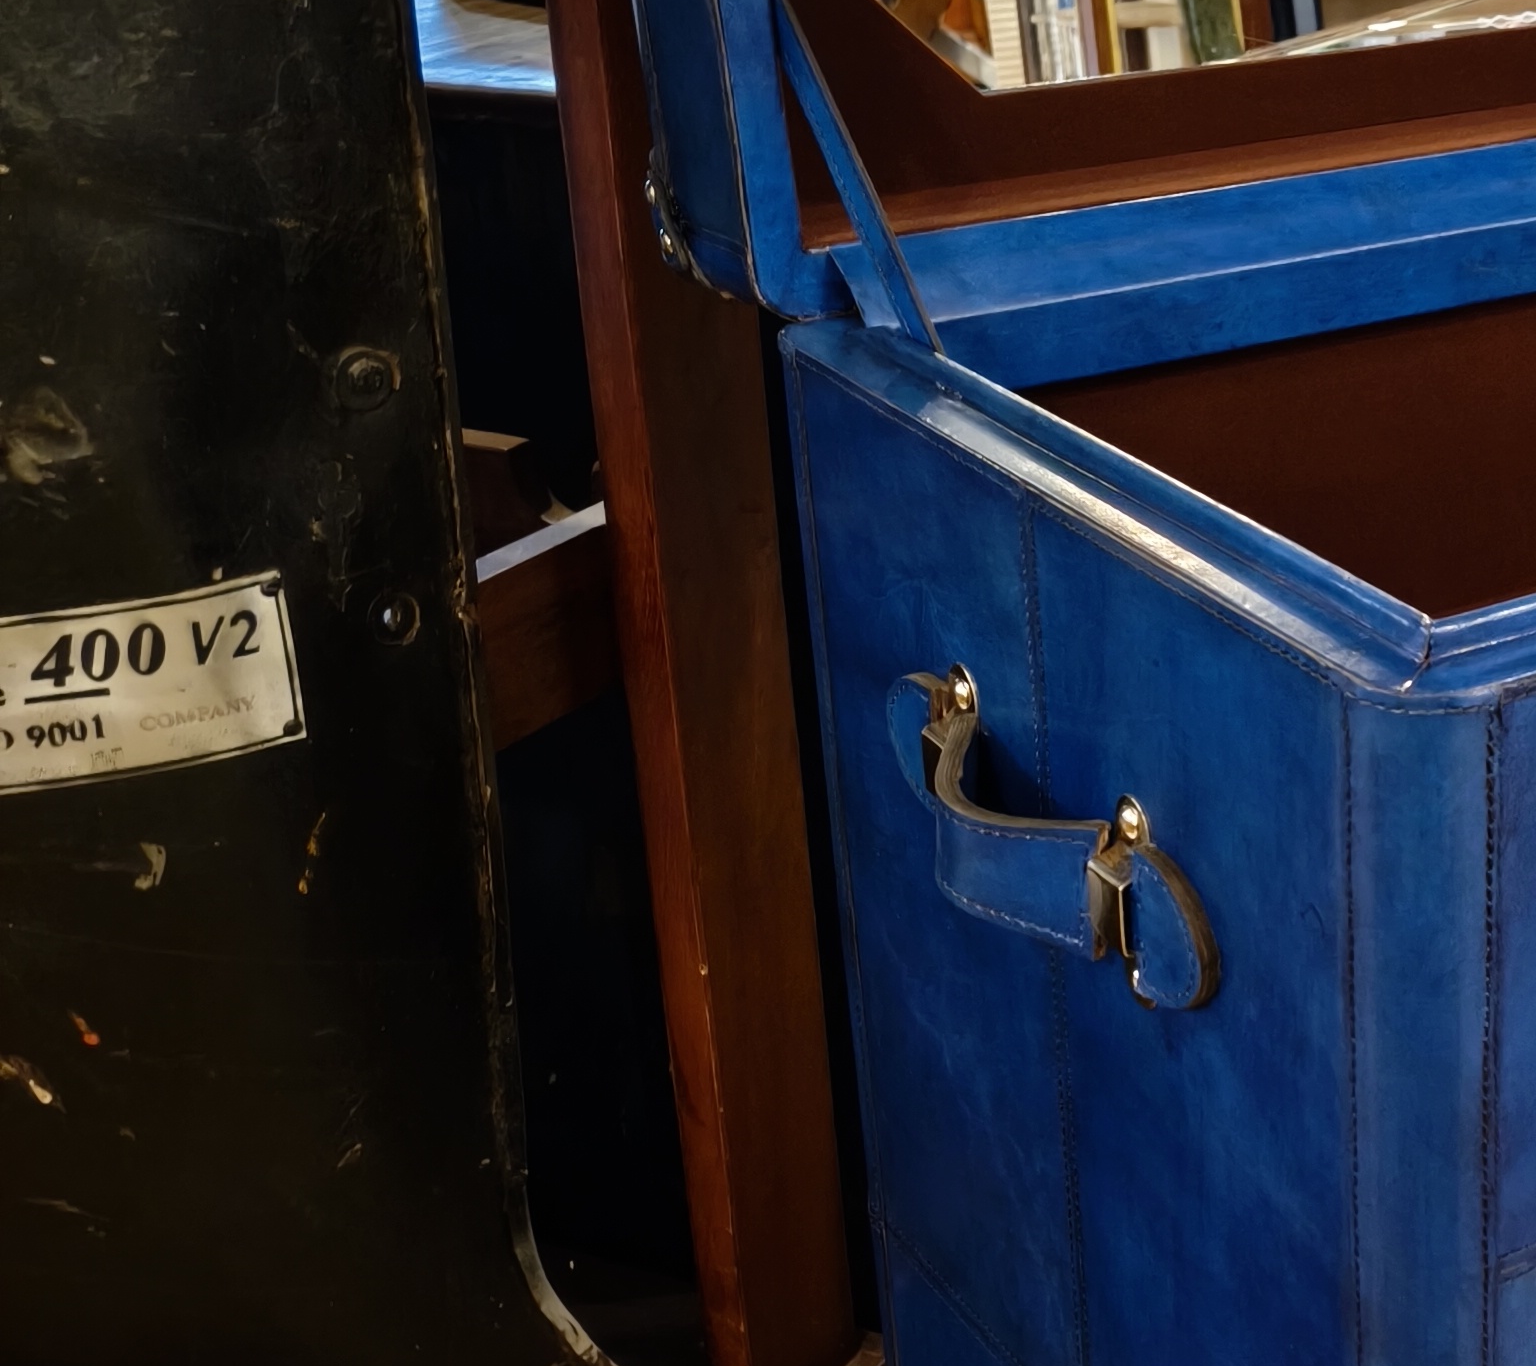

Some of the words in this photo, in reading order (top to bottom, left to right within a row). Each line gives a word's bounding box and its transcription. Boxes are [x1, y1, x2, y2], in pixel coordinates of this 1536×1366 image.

[30, 623, 166, 687] 400
[191, 609, 260, 666] V2
[26, 713, 105, 749] 9001
[139, 694, 256, 732] COMPANY
